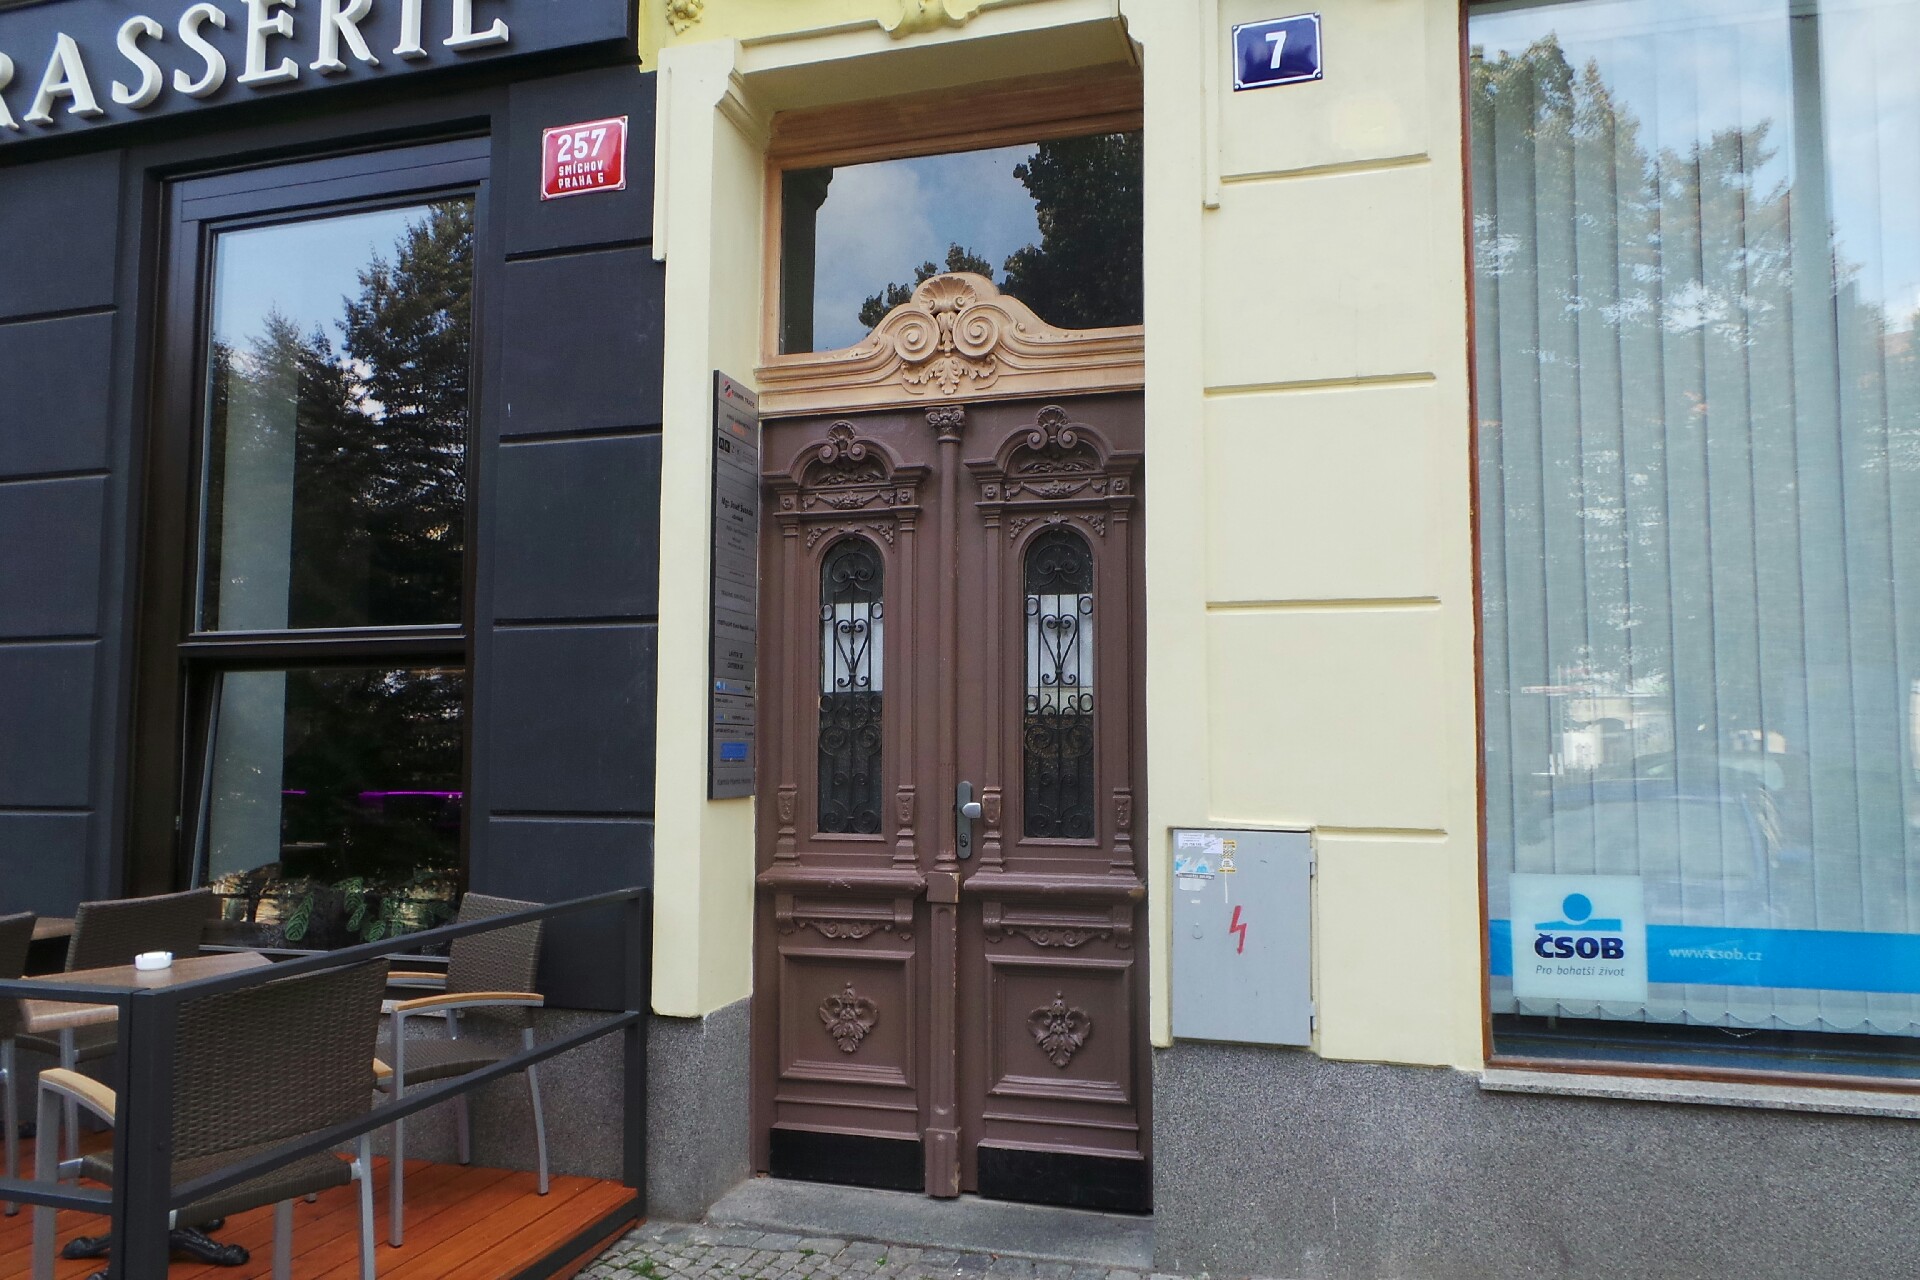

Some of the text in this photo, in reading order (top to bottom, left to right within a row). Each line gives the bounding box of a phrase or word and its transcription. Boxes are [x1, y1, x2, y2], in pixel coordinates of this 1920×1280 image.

[1265, 30, 1287, 69] 7
[0, 0, 510, 131] ASSERI
[557, 128, 607, 163] 257
[558, 160, 604, 177] SMÍCHOV
[558, 174, 593, 189] PRAHA
[1534, 933, 1625, 959] ČSOB
[1668, 947, 1763, 961] www.csob.cz
[1535, 965, 1626, 977] Pro bohatší život
